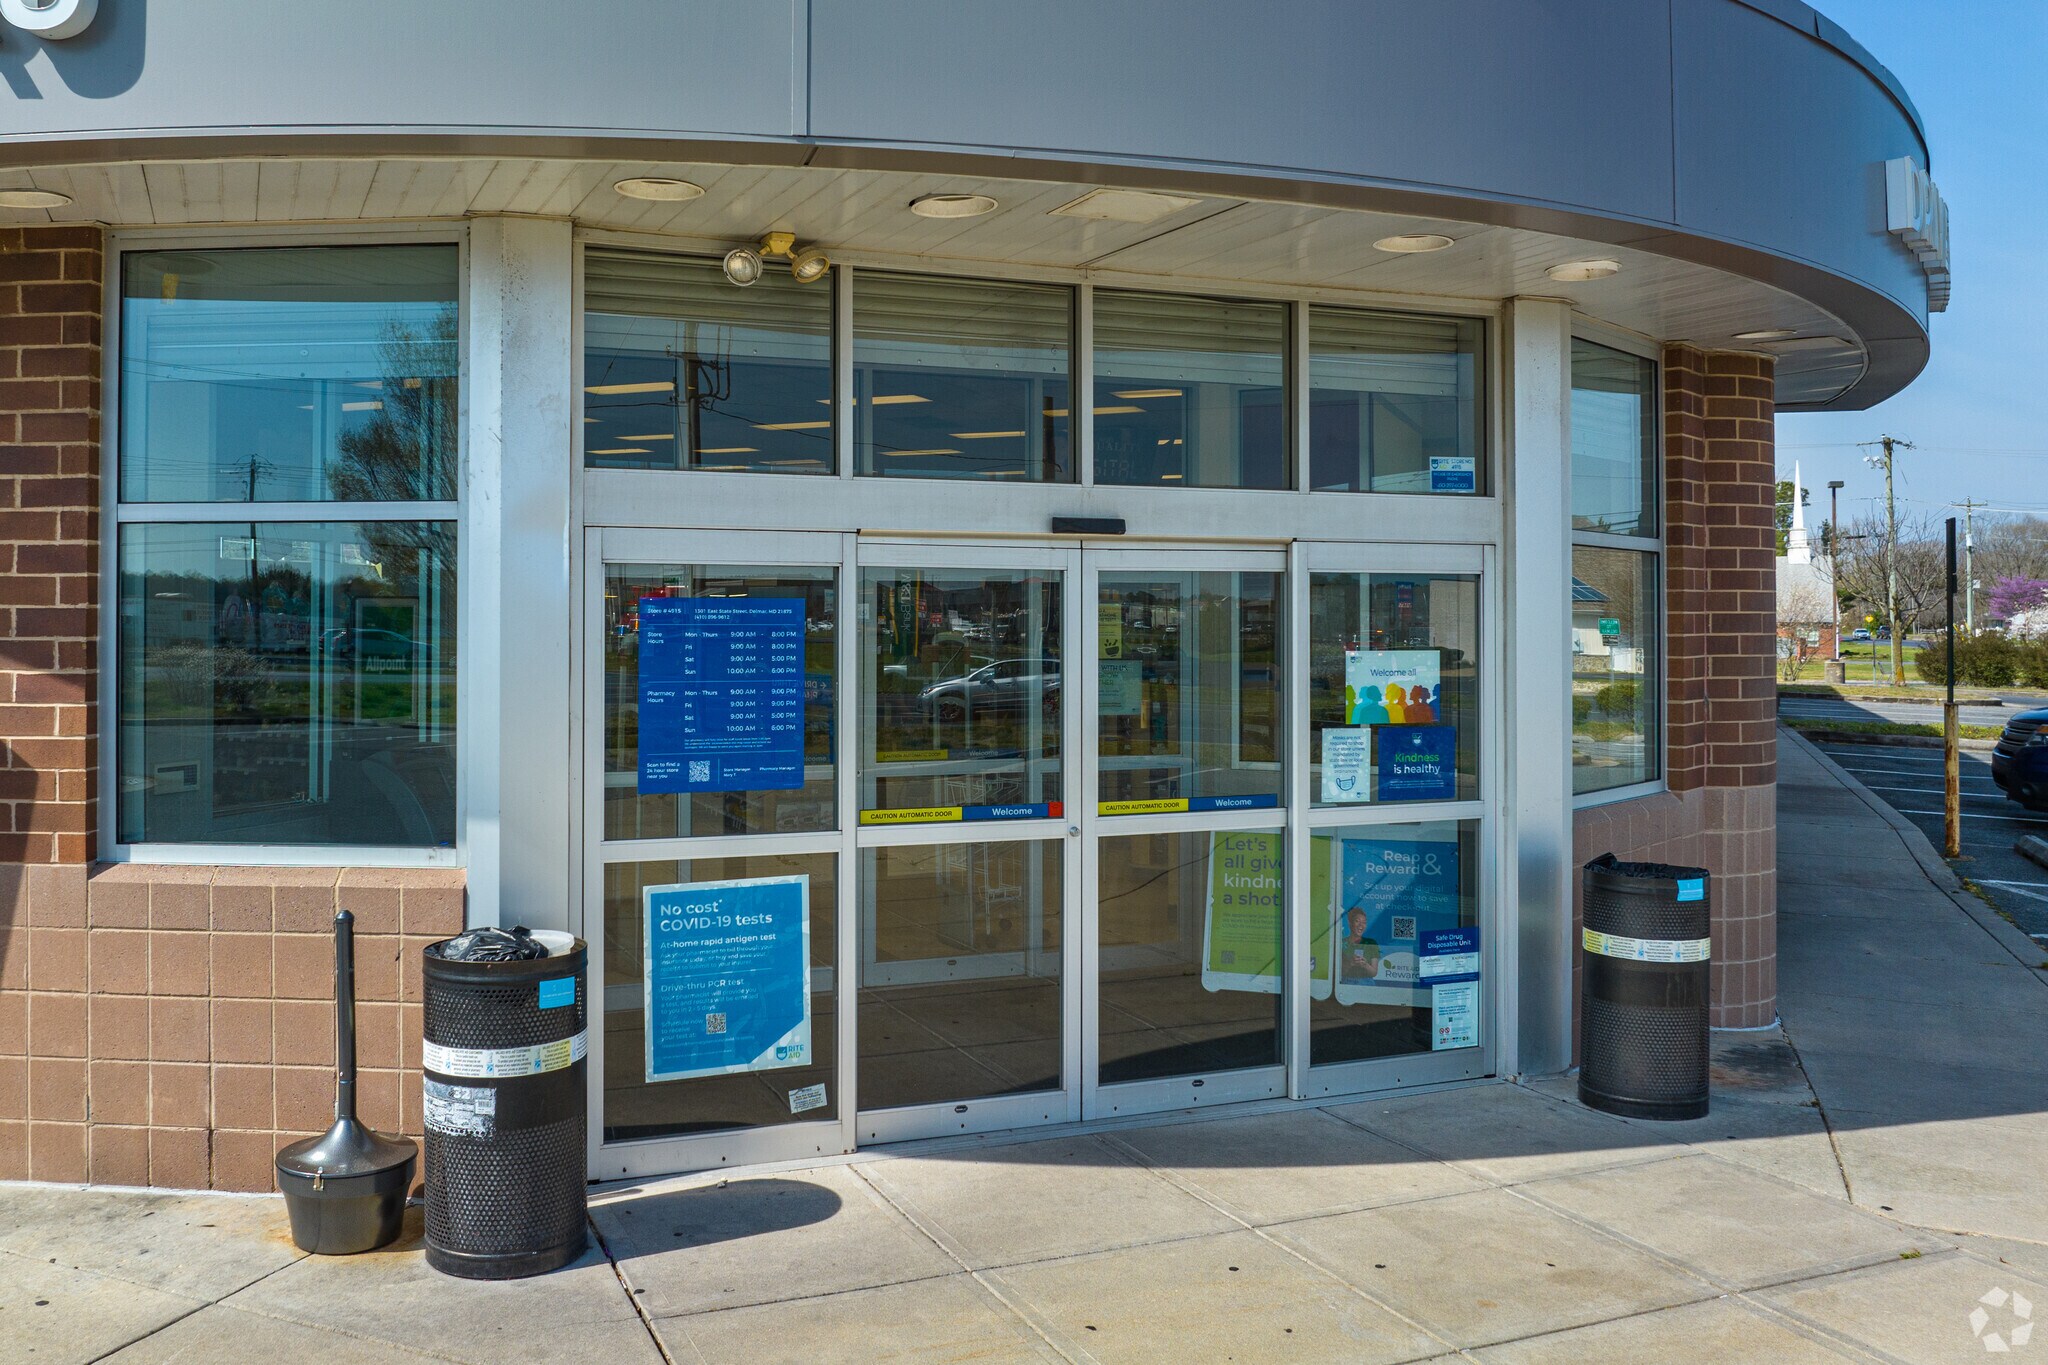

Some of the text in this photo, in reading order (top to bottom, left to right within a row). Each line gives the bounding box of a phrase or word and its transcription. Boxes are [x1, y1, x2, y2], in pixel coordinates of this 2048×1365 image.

[366, 656, 406, 674] Allpoint
[1370, 668, 1416, 677] Welcome all
[1395, 753, 1440, 762] Kindness
[1393, 764, 1441, 775] is healthy
[1215, 798, 1253, 807] Welcome
[992, 807, 1033, 817] Welcome
[1224, 836, 1268, 852] Let's
[1224, 854, 1245, 869] all
[1384, 850, 1442, 876] Reap &
[1365, 862, 1420, 875] Reward
[1380, 884, 1393, 892] up
[1393, 884, 1414, 892] your
[1414, 884, 1444, 894] digital
[1222, 893, 1233, 905] a
[1360, 892, 1394, 900] account
[660, 904, 682, 916] No
[660, 912, 773, 932] COVID-19 tests
[660, 933, 776, 950] At-home rapid antigen test
[1427, 940, 1472, 950] Disposable Unit
[660, 978, 744, 993] Drive-thru PCR test
